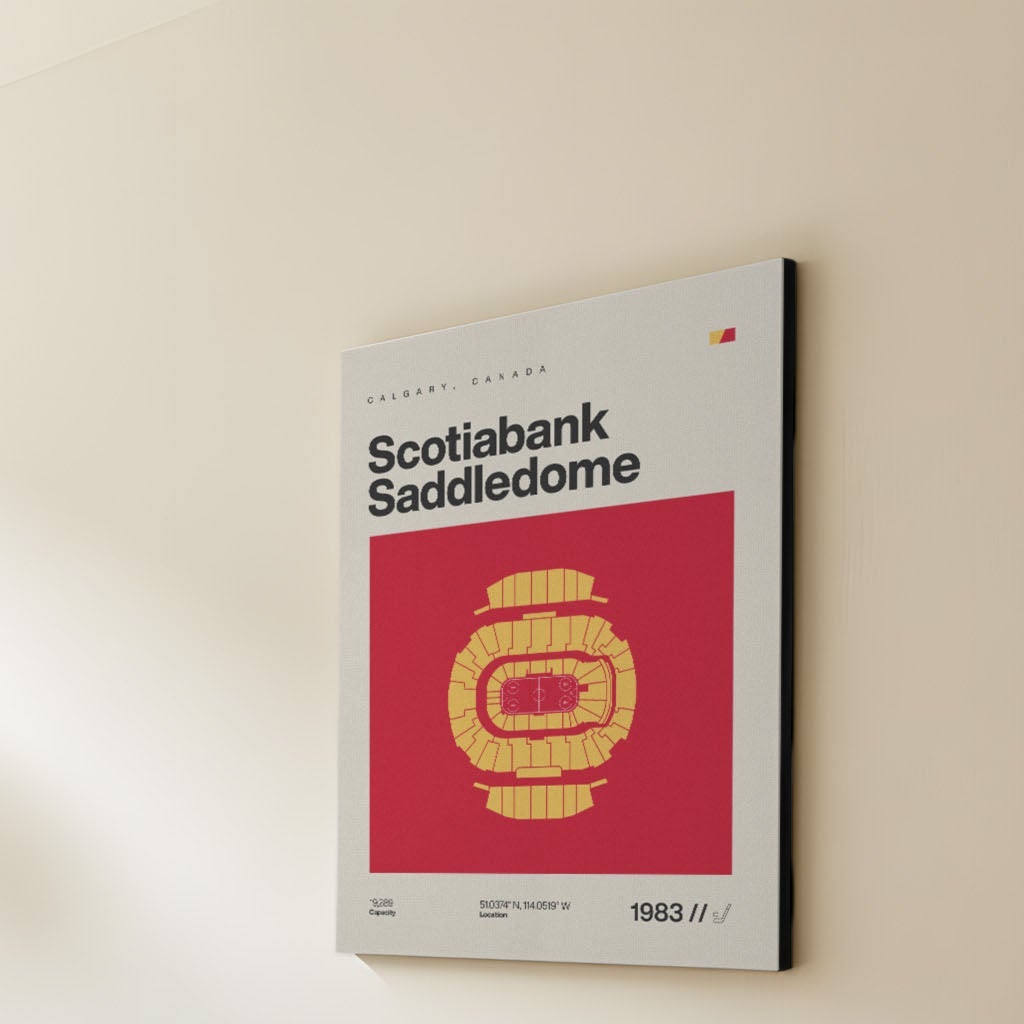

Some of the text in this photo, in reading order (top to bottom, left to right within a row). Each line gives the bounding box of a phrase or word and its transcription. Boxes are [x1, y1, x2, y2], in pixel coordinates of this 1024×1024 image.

[471, 365, 547, 386] CANADA
[368, 401, 610, 475] Scotiabank
[368, 451, 641, 518] Saddledome
[368, 908, 397, 918] Capacity
[479, 911, 508, 919] Location
[561, 901, 572, 911] W
[630, 902, 684, 922] 1983
